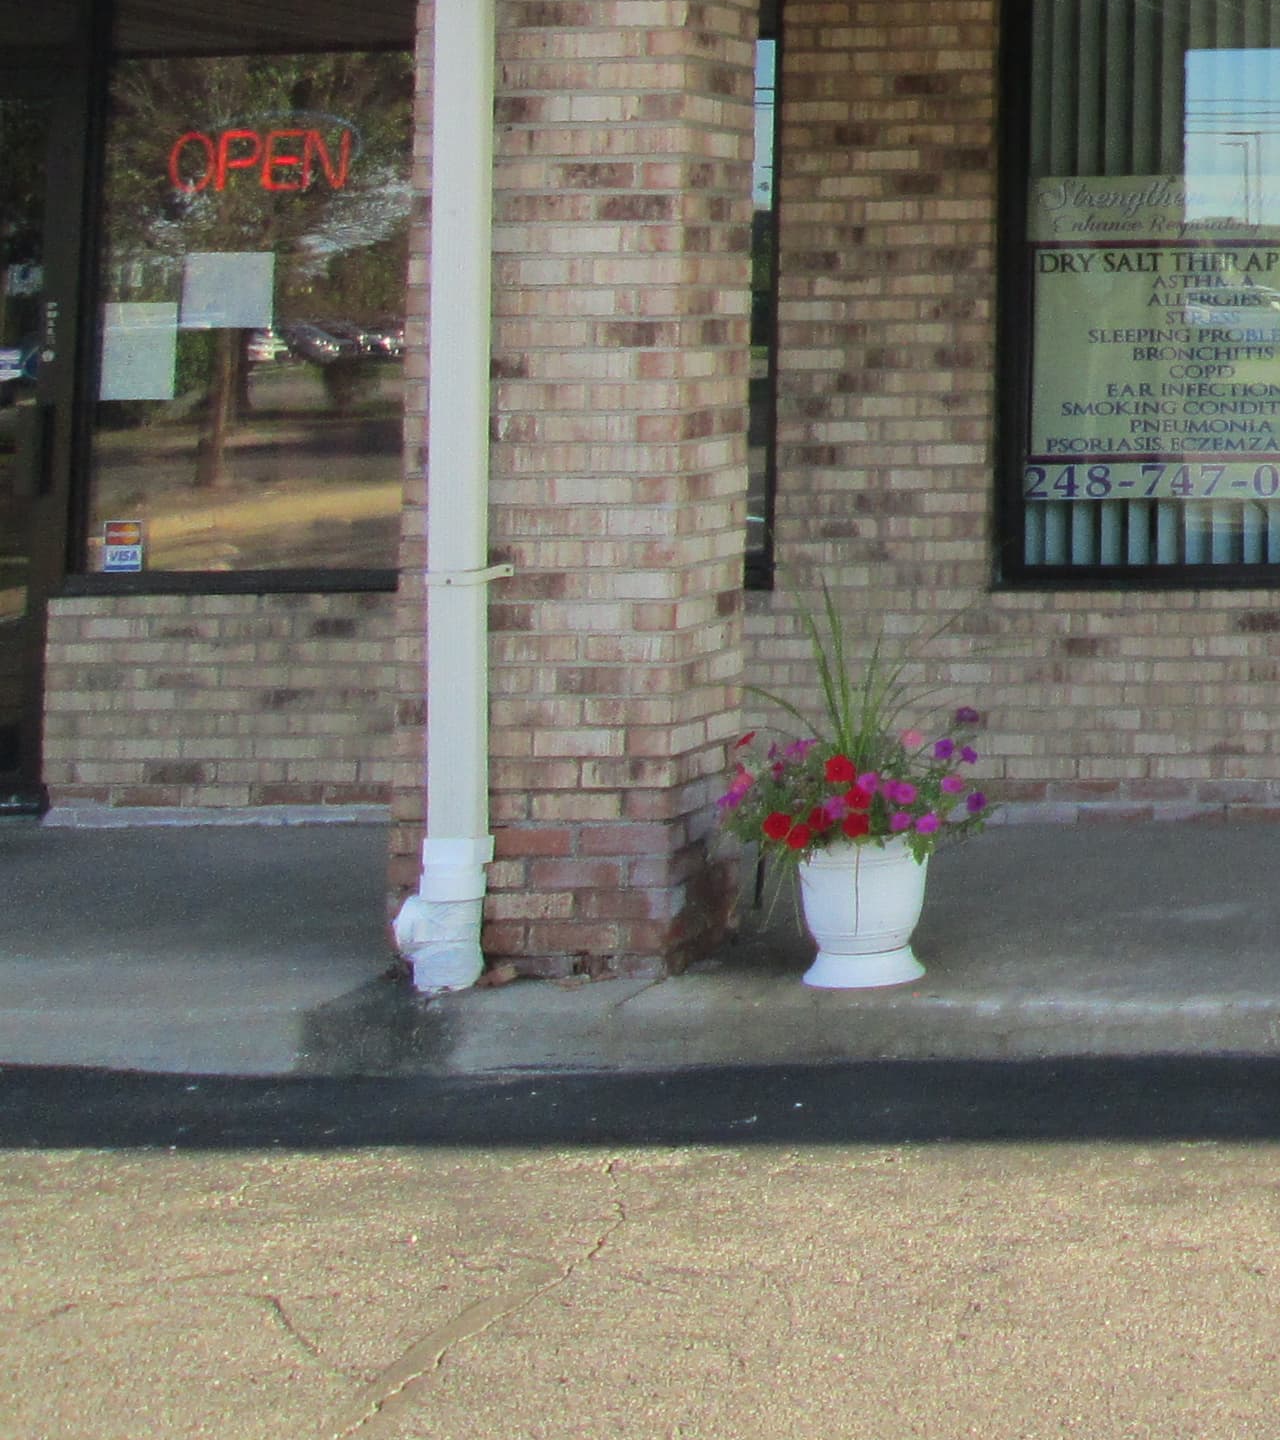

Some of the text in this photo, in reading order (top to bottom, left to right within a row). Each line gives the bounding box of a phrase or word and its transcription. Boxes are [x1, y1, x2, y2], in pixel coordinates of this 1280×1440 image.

[168, 127, 353, 193] OPEN
[1039, 176, 1203, 217] Strengthe
[1051, 215, 1143, 233] Enhance
[1038, 252, 1099, 273] DRY
[1103, 250, 1164, 273] SALT
[1147, 292, 1263, 308] ALLERGIES
[1165, 310, 1241, 326] STRESS
[1088, 328, 1191, 344] SLEEPING
[1132, 346, 1275, 362] BRONCHITIS
[1169, 364, 1237, 379] COPD
[1107, 383, 1155, 398] EAR
[1061, 401, 1177, 416] SMOKING
[1130, 419, 1273, 434] PNEUMONIA
[109, 550, 138, 561] VISA
